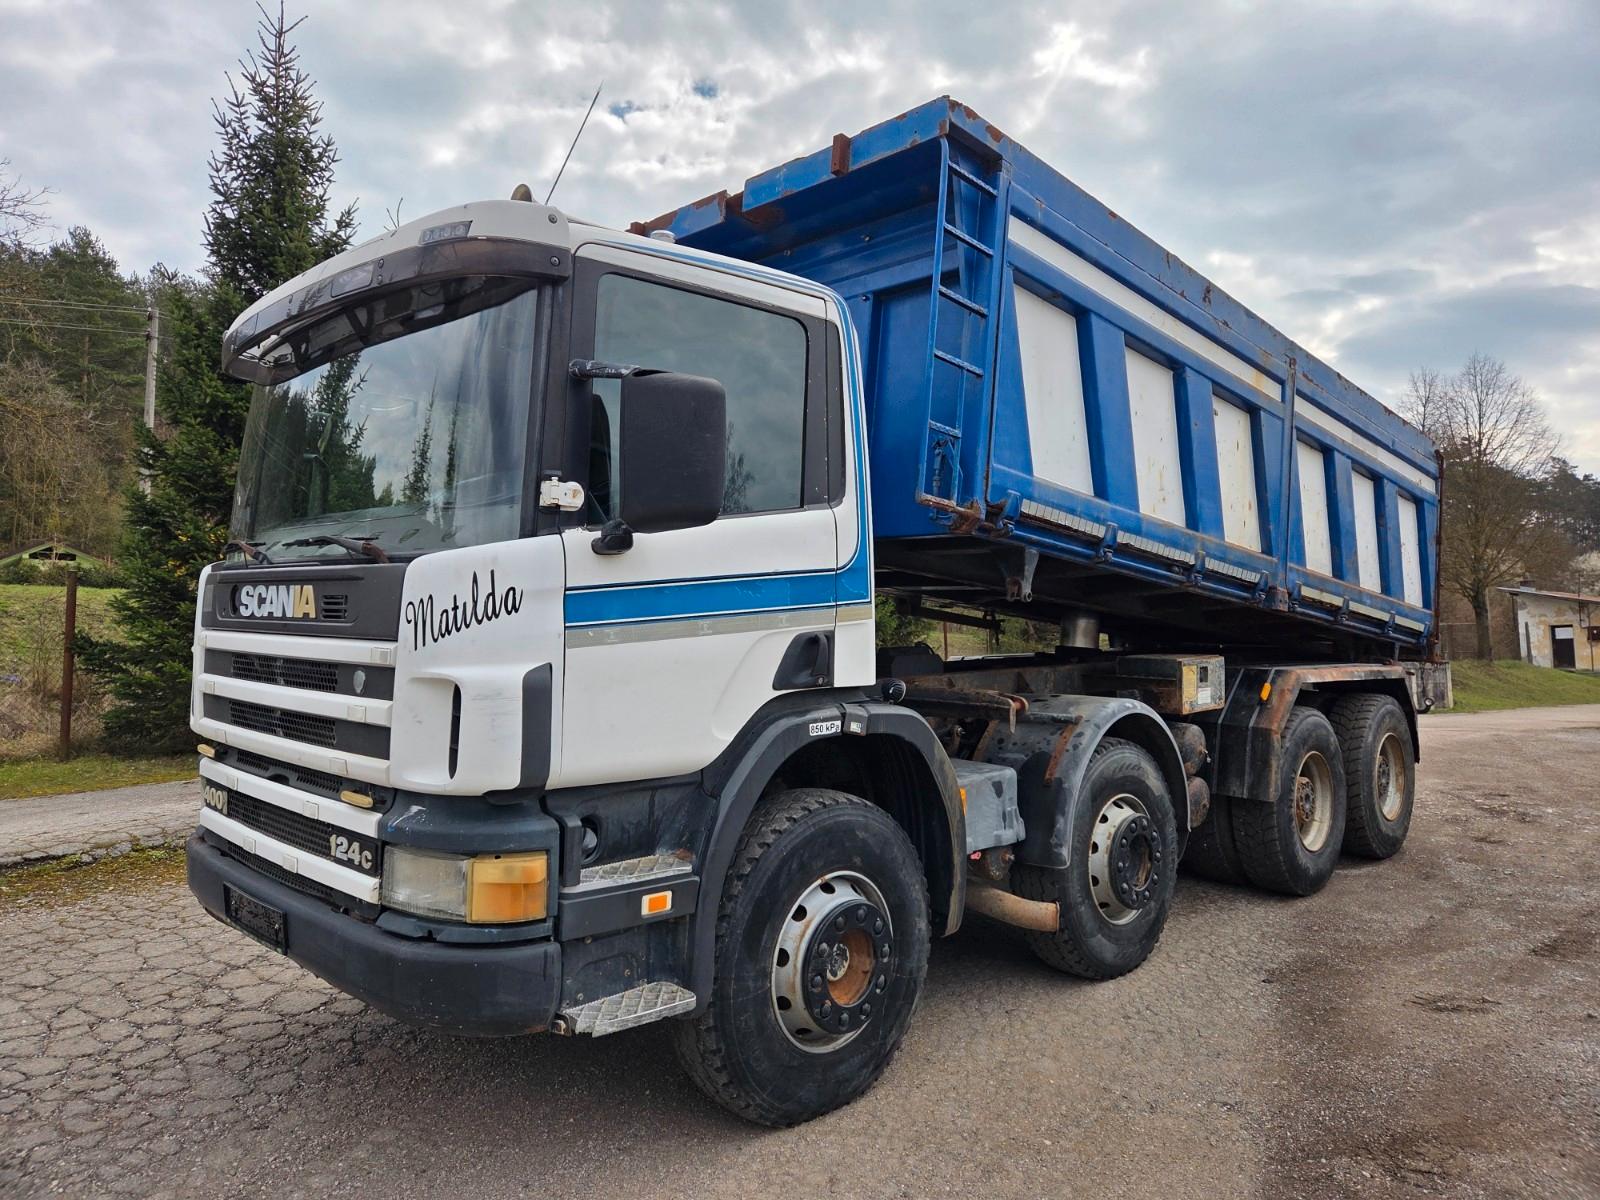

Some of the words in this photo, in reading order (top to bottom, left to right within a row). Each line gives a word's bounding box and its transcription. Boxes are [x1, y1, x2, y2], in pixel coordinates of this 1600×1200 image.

[240, 585, 316, 618] SCANIA
[405, 568, 523, 651] Matilda
[810, 723, 824, 735] 850
[825, 722, 840, 733] kPa
